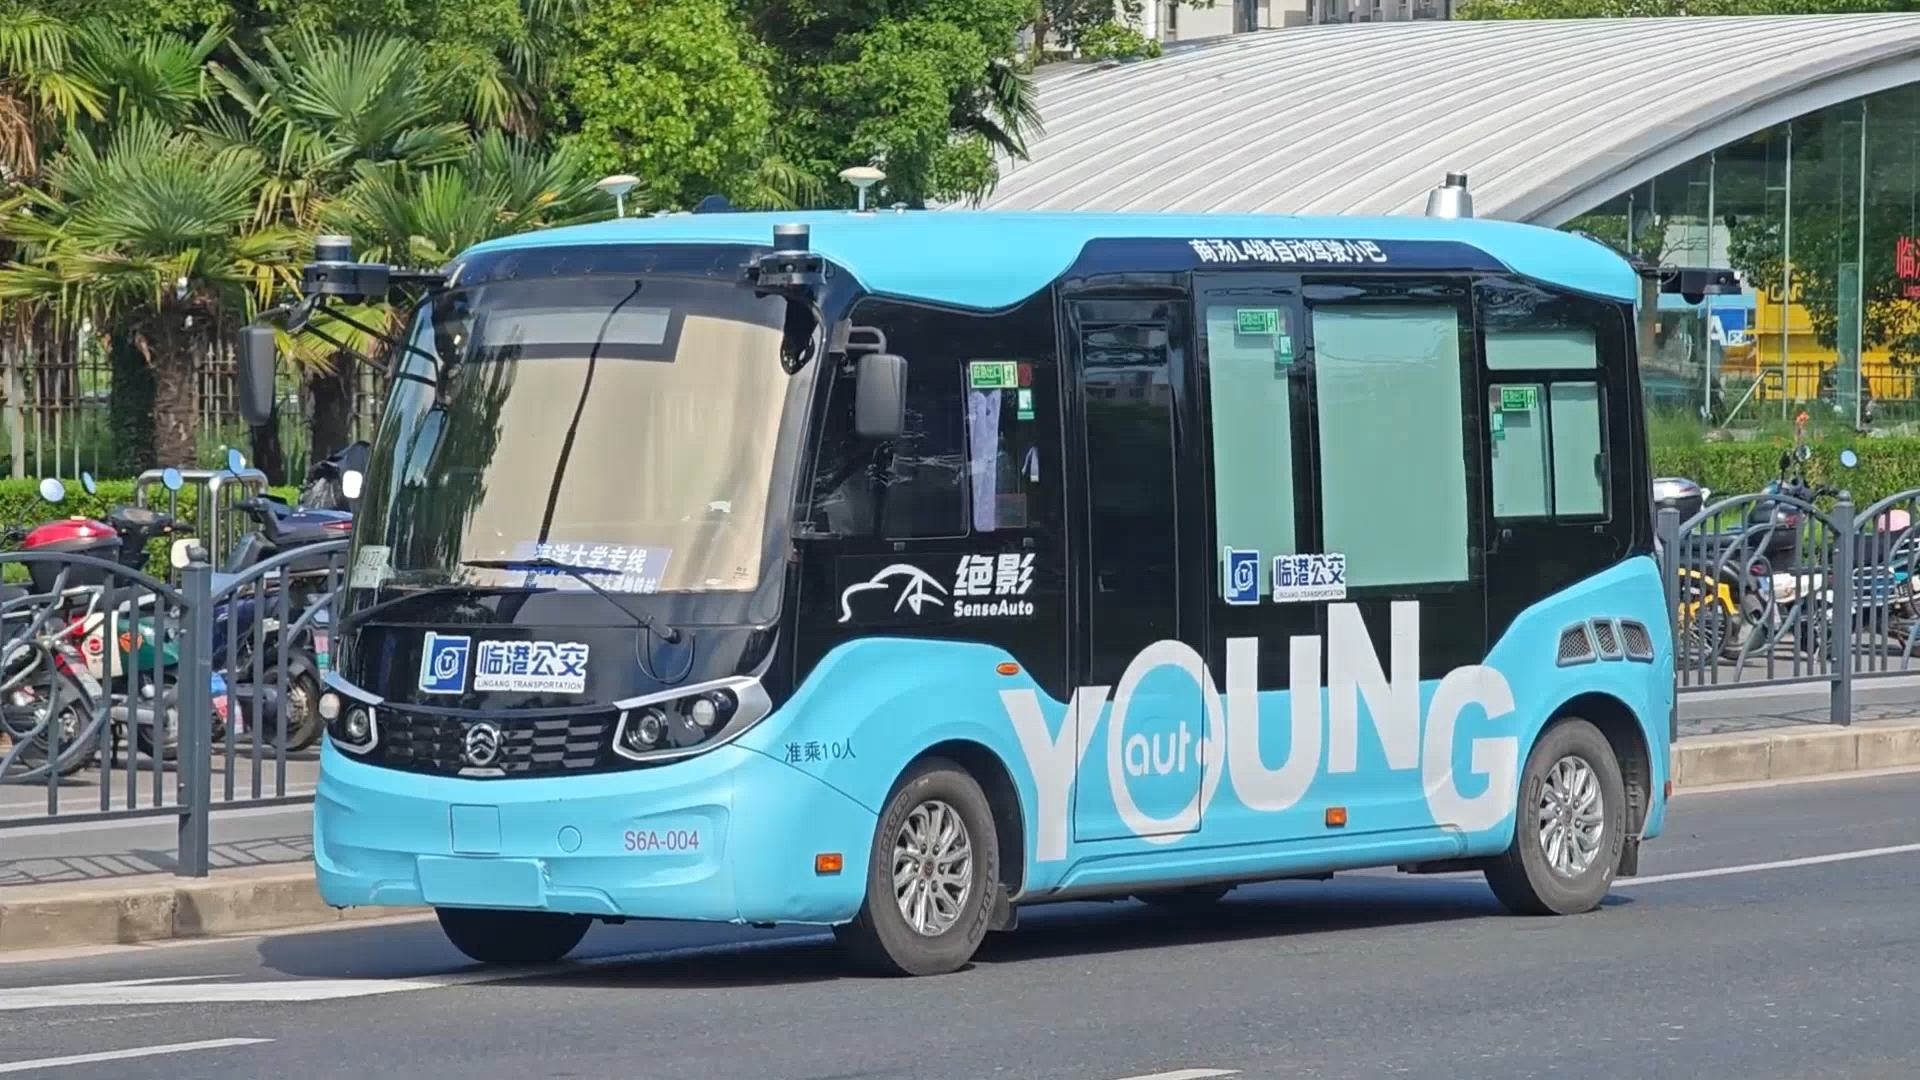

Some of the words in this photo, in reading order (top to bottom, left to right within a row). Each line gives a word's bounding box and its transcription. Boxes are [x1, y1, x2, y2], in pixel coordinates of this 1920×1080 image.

[1189, 238, 1387, 263] 商汤L4级自动驾驶小巴
[953, 553, 1035, 596] 绝影
[1275, 556, 1345, 587] 临港公交
[954, 600, 1035, 618] SenseAuto
[478, 644, 588, 677] 临港公交
[477, 679, 510, 688] LINGANG
[513, 680, 583, 690] TRANSPORTATION
[999, 600, 1518, 862] YOUNG
[784, 738, 856, 763] 准乘10人
[624, 830, 700, 851] S6A-004
